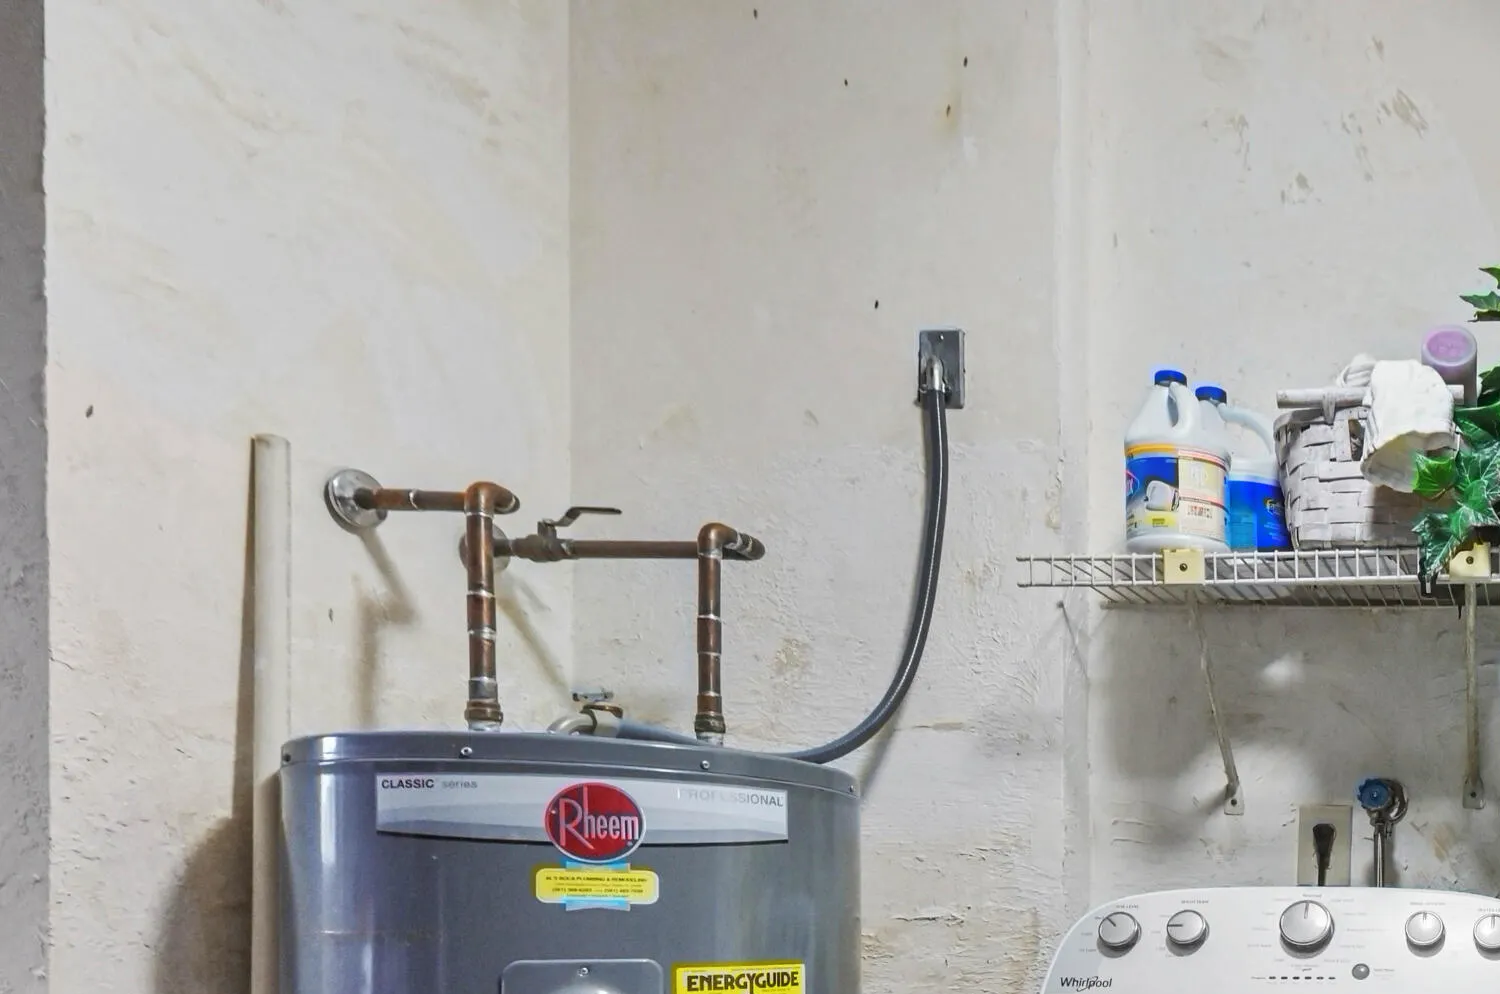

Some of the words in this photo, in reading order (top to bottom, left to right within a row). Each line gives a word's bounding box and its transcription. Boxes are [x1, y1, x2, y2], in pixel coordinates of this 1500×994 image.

[381, 779, 434, 789] CLASSIC
[443, 780, 477, 789] series
[679, 788, 784, 807] PROFSSIONAL
[560, 786, 639, 850] Rheem
[687, 971, 799, 994] ENERGYGUIDE
[1060, 976, 1112, 992] Whirlpool
